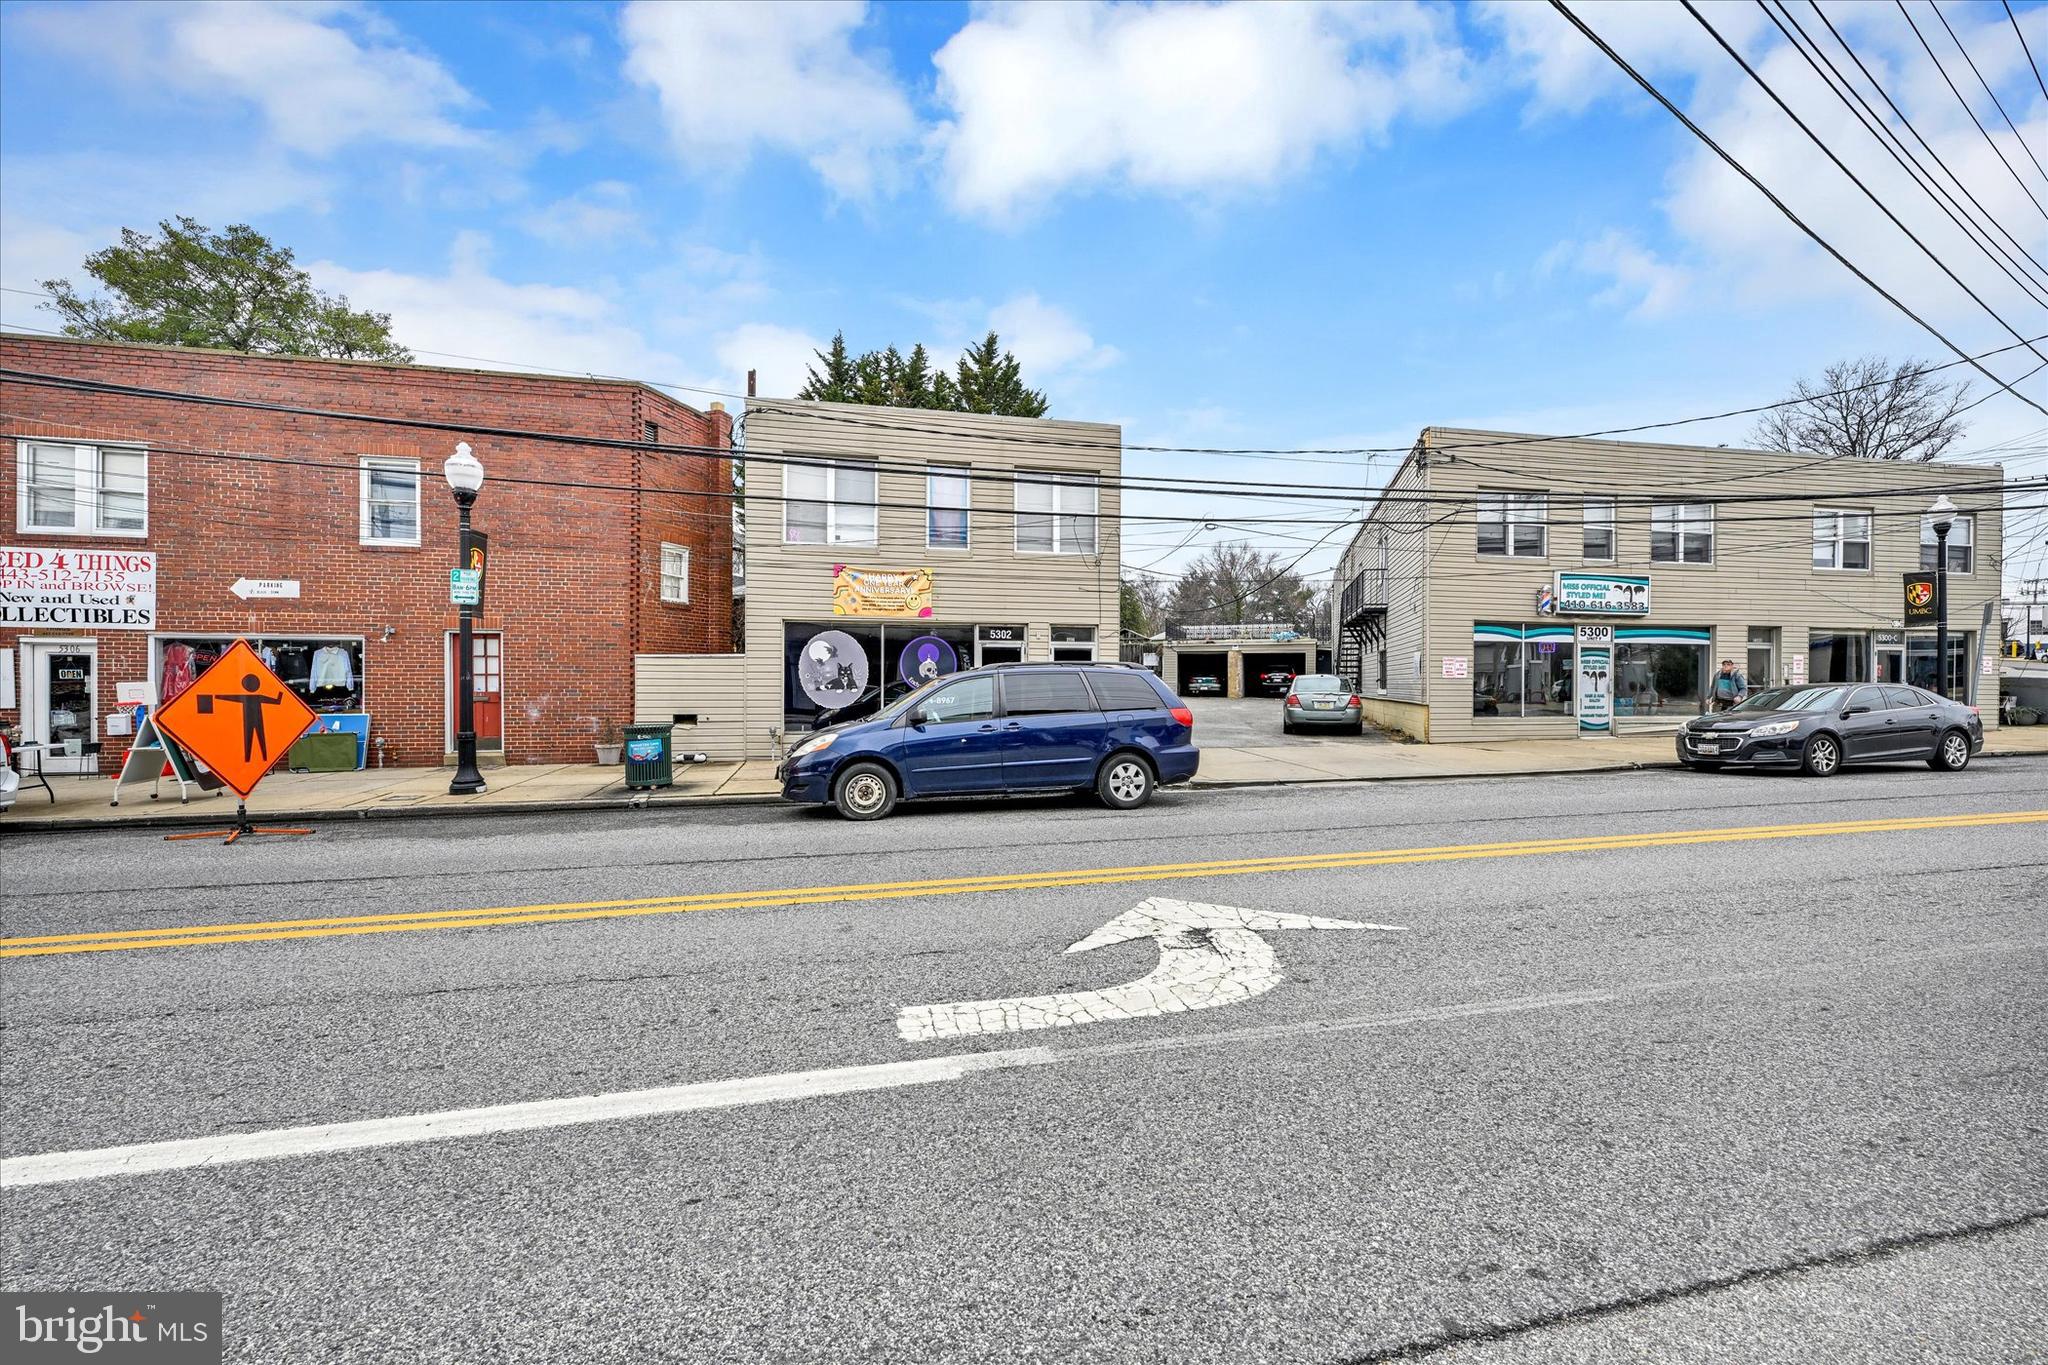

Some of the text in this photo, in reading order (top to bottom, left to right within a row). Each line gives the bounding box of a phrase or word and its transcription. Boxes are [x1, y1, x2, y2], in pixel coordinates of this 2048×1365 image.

[49, 553, 69, 570] 4
[74, 553, 151, 573] THINGS
[453, 571, 459, 580] 2
[0, 581, 152, 593] P IN and BROWSE!
[1580, 583, 1610, 591] OFFICIAL
[0, 592, 120, 605] New and Used
[0, 606, 150, 625] LLECTIBLES
[1909, 607, 1932, 615] UMBC
[990, 630, 1012, 639] 5302
[1580, 627, 1608, 637] 5300
[59, 644, 81, 653] 5306
